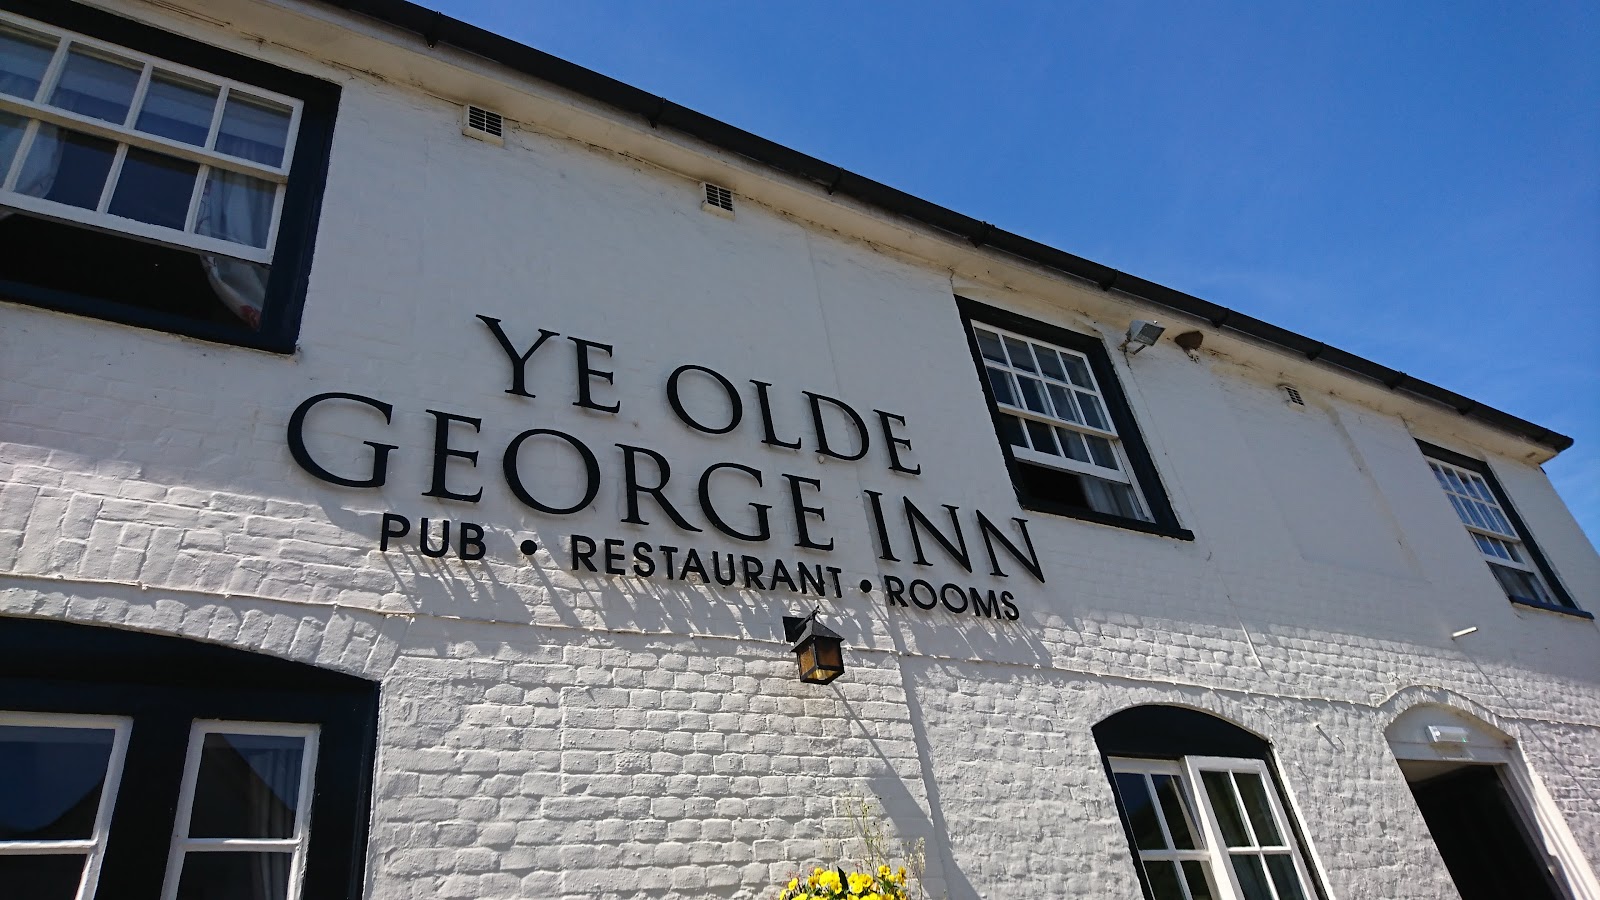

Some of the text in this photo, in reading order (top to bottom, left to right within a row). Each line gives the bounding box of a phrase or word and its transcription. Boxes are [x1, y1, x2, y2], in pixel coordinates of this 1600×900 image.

[475, 313, 922, 476] YE OLDE
[286, 391, 1046, 584] GEORGE INN
[379, 512, 1021, 621] PUB RESTAURANT ROOMS
